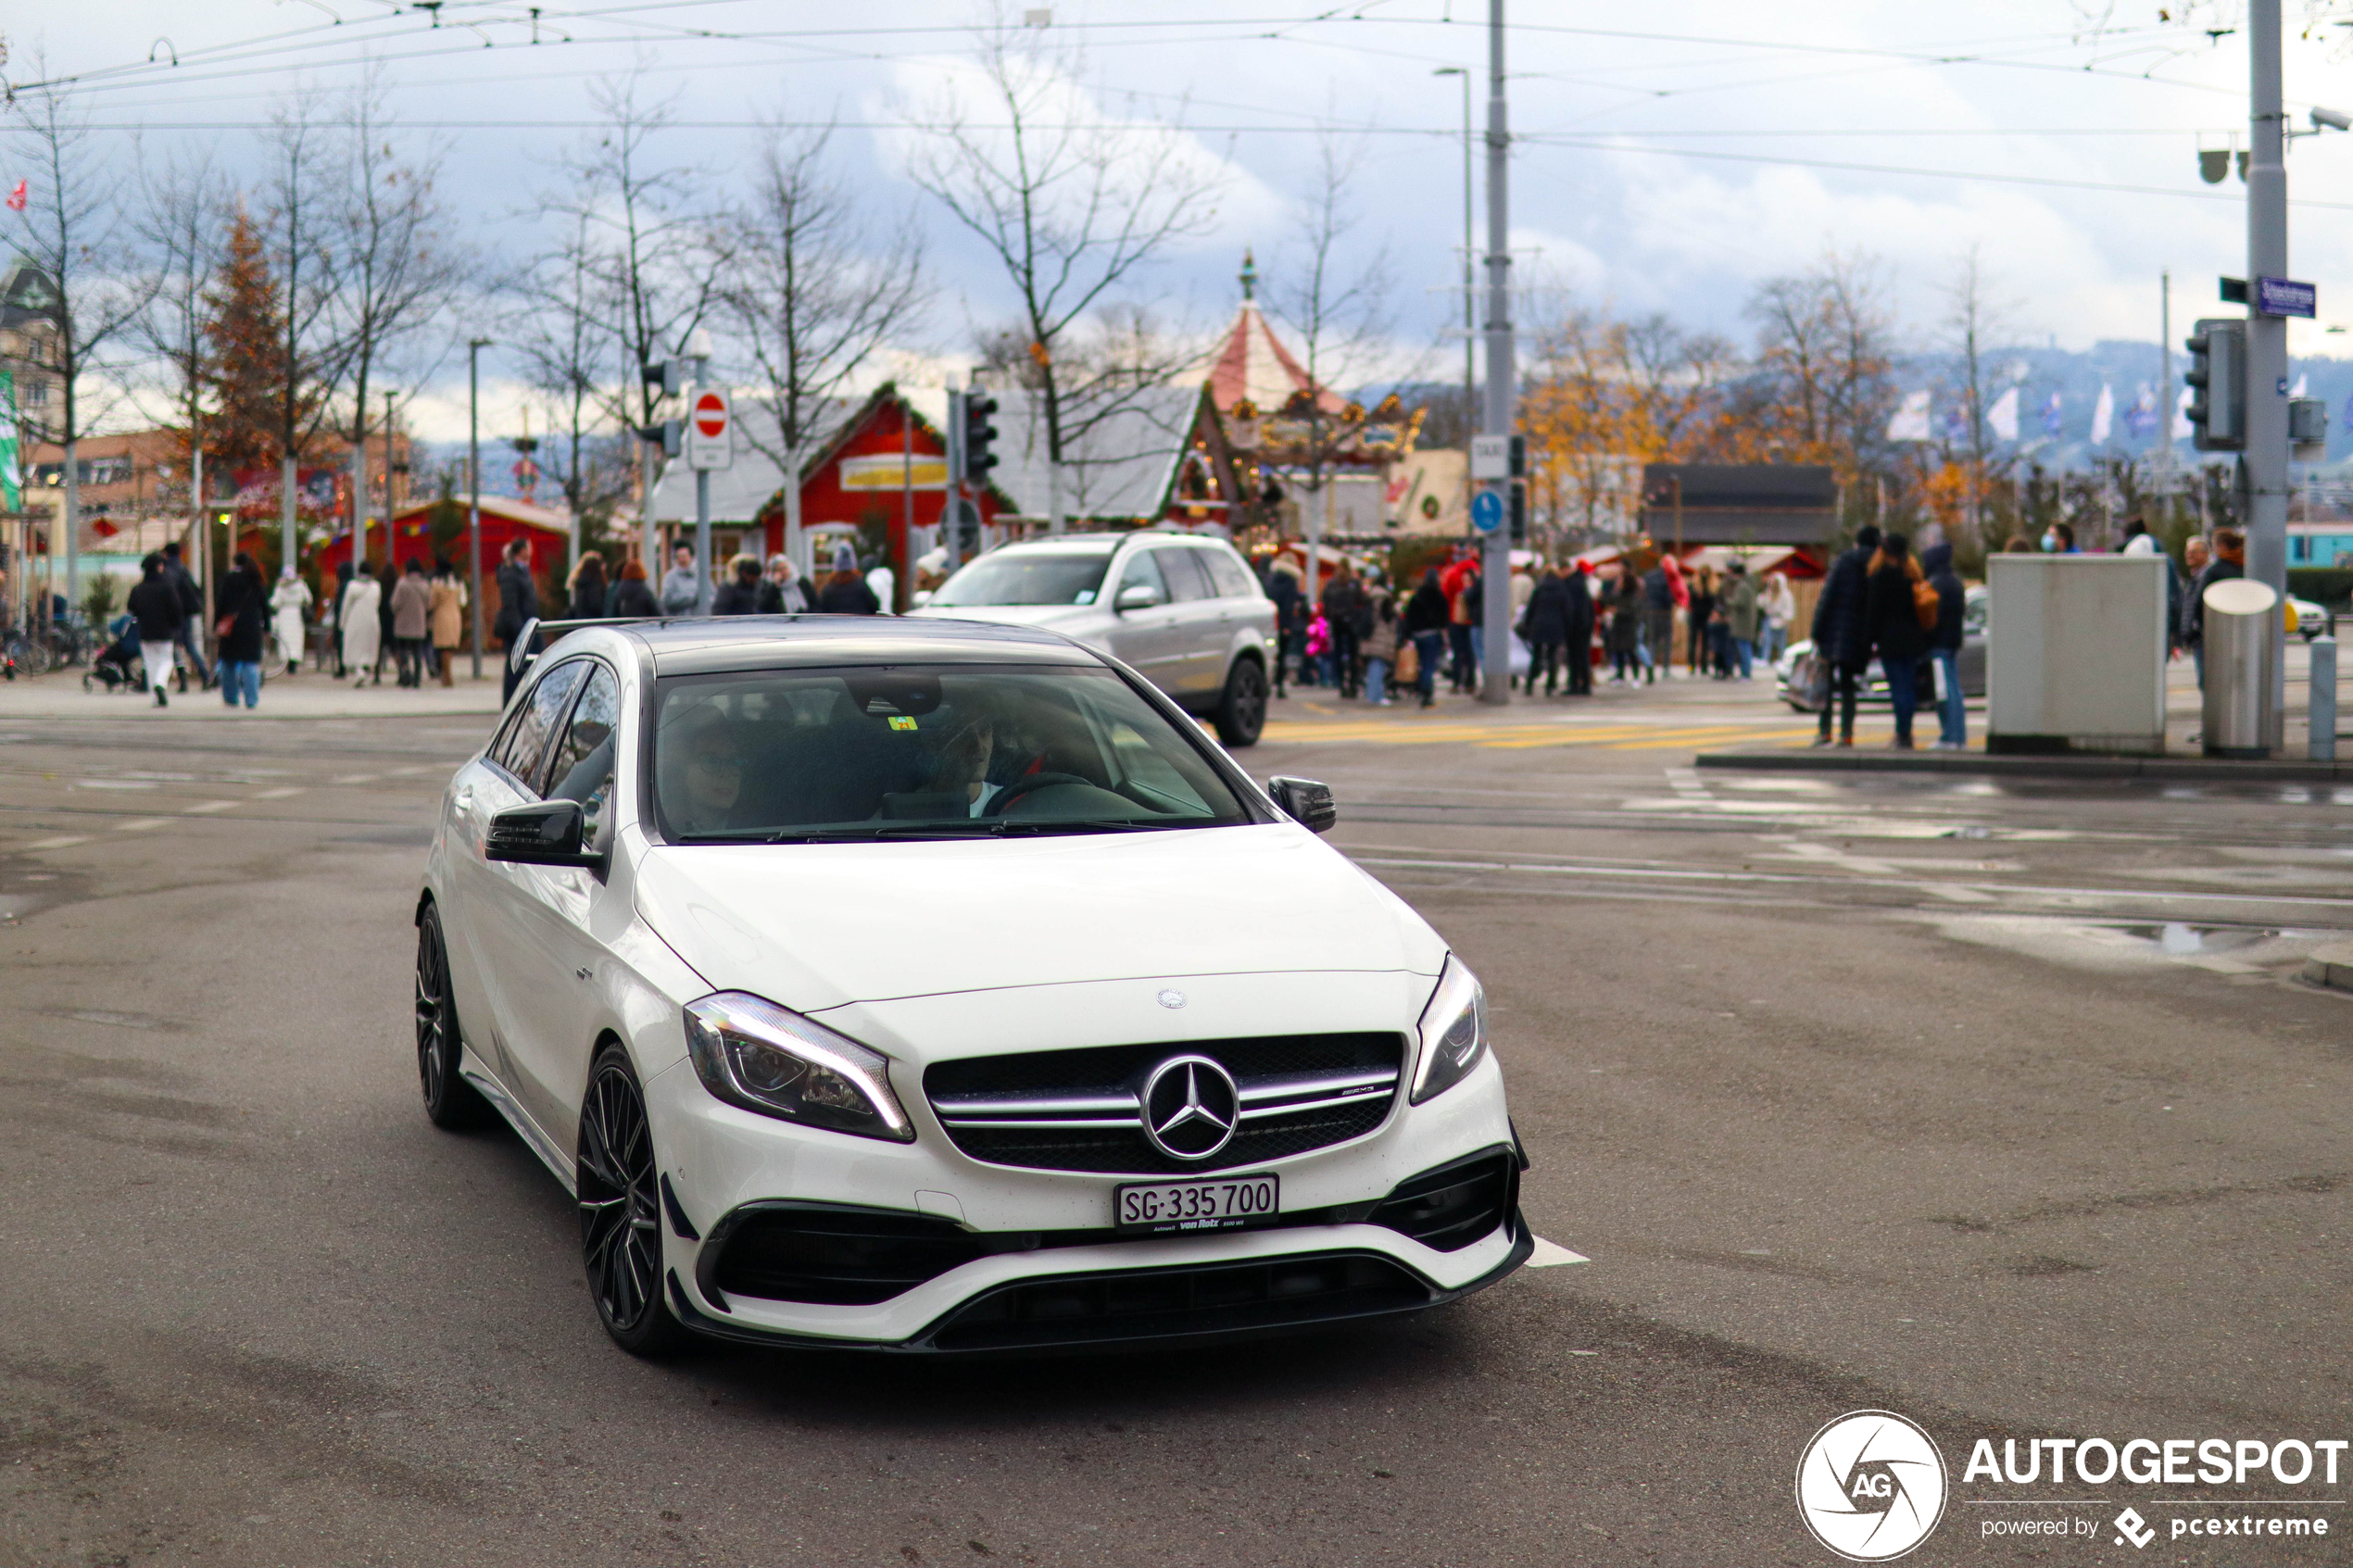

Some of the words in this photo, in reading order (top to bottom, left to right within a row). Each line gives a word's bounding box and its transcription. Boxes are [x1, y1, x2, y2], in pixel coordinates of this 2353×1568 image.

[1222, 1182, 1271, 1214] 700
[1179, 1221, 1198, 1230] von
[1198, 1218, 1219, 1228] Rotz
